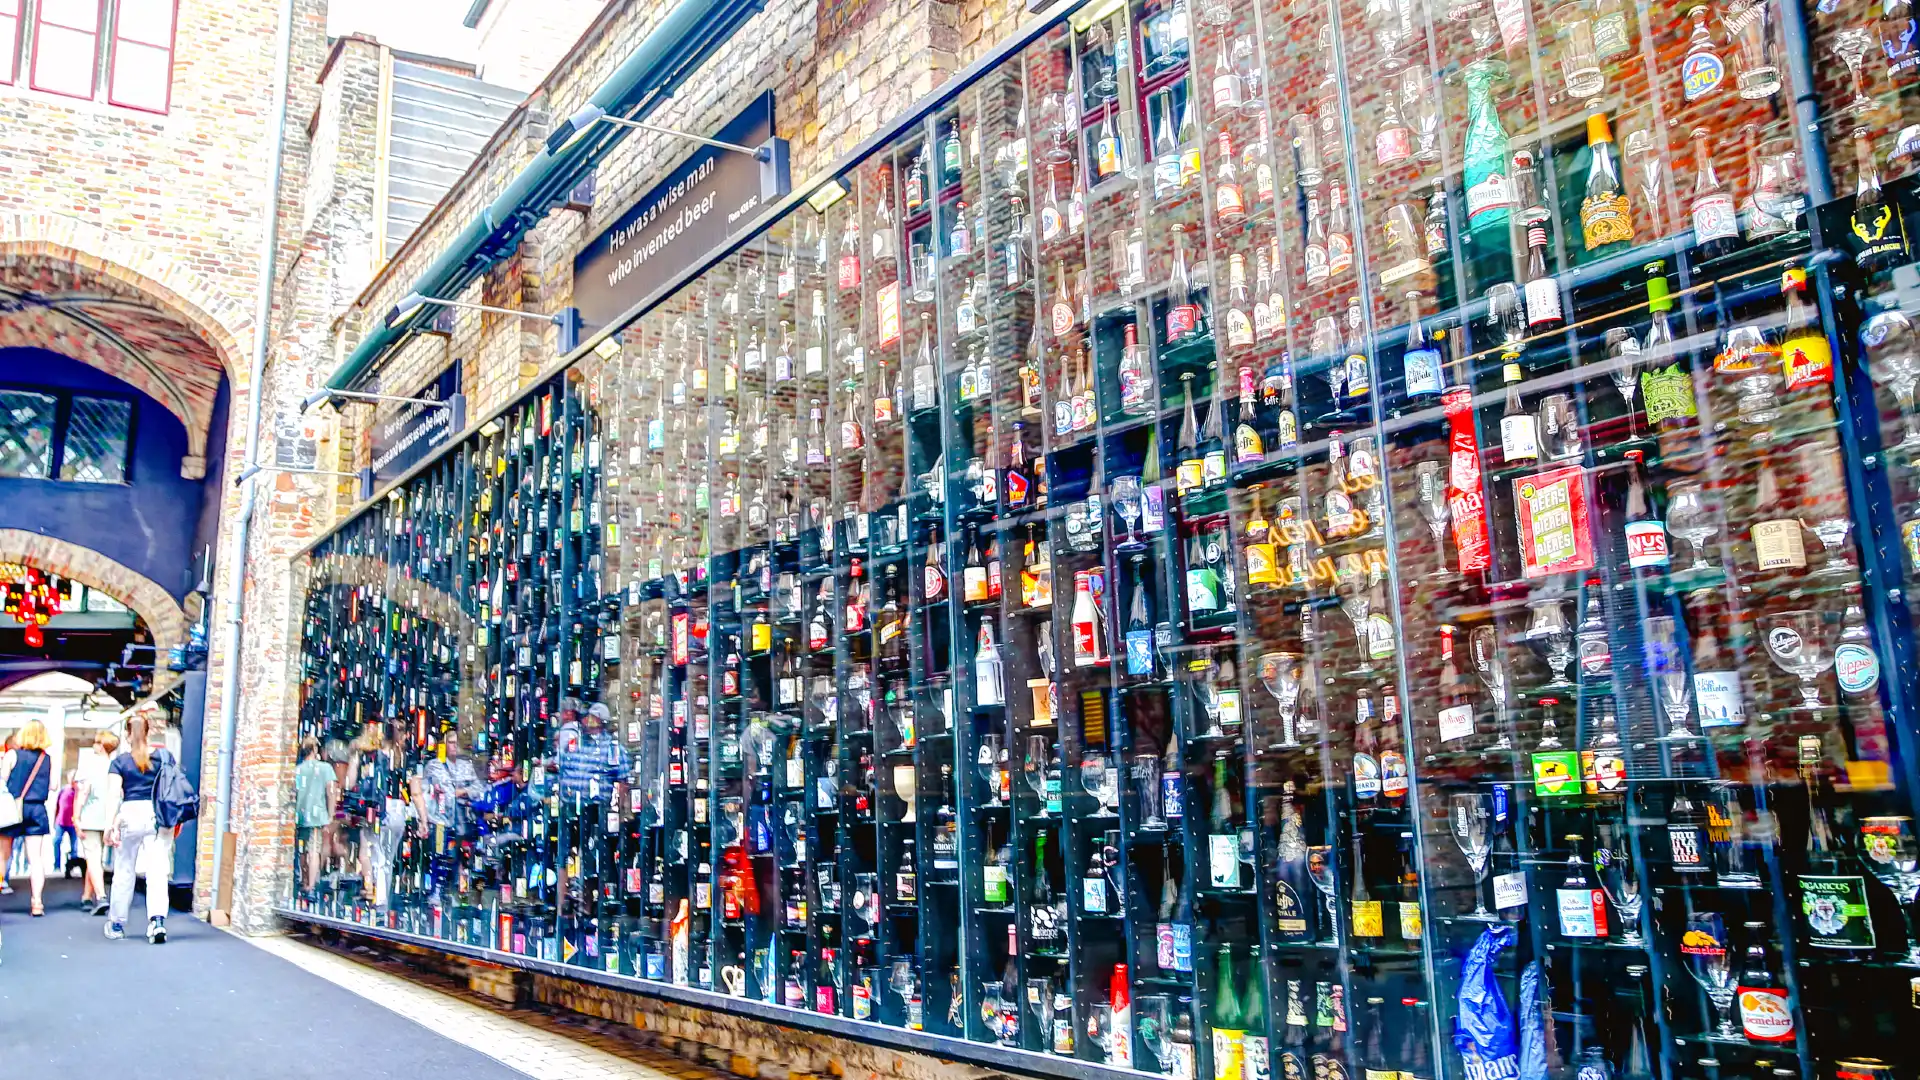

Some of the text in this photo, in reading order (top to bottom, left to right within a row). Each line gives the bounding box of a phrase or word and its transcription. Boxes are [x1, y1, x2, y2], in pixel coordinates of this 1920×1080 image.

[610, 156, 714, 254] He was a wise man
[608, 190, 716, 287] who invented beer
[1531, 488, 1566, 513] BEERS
[1535, 508, 1570, 536] BIEREN
